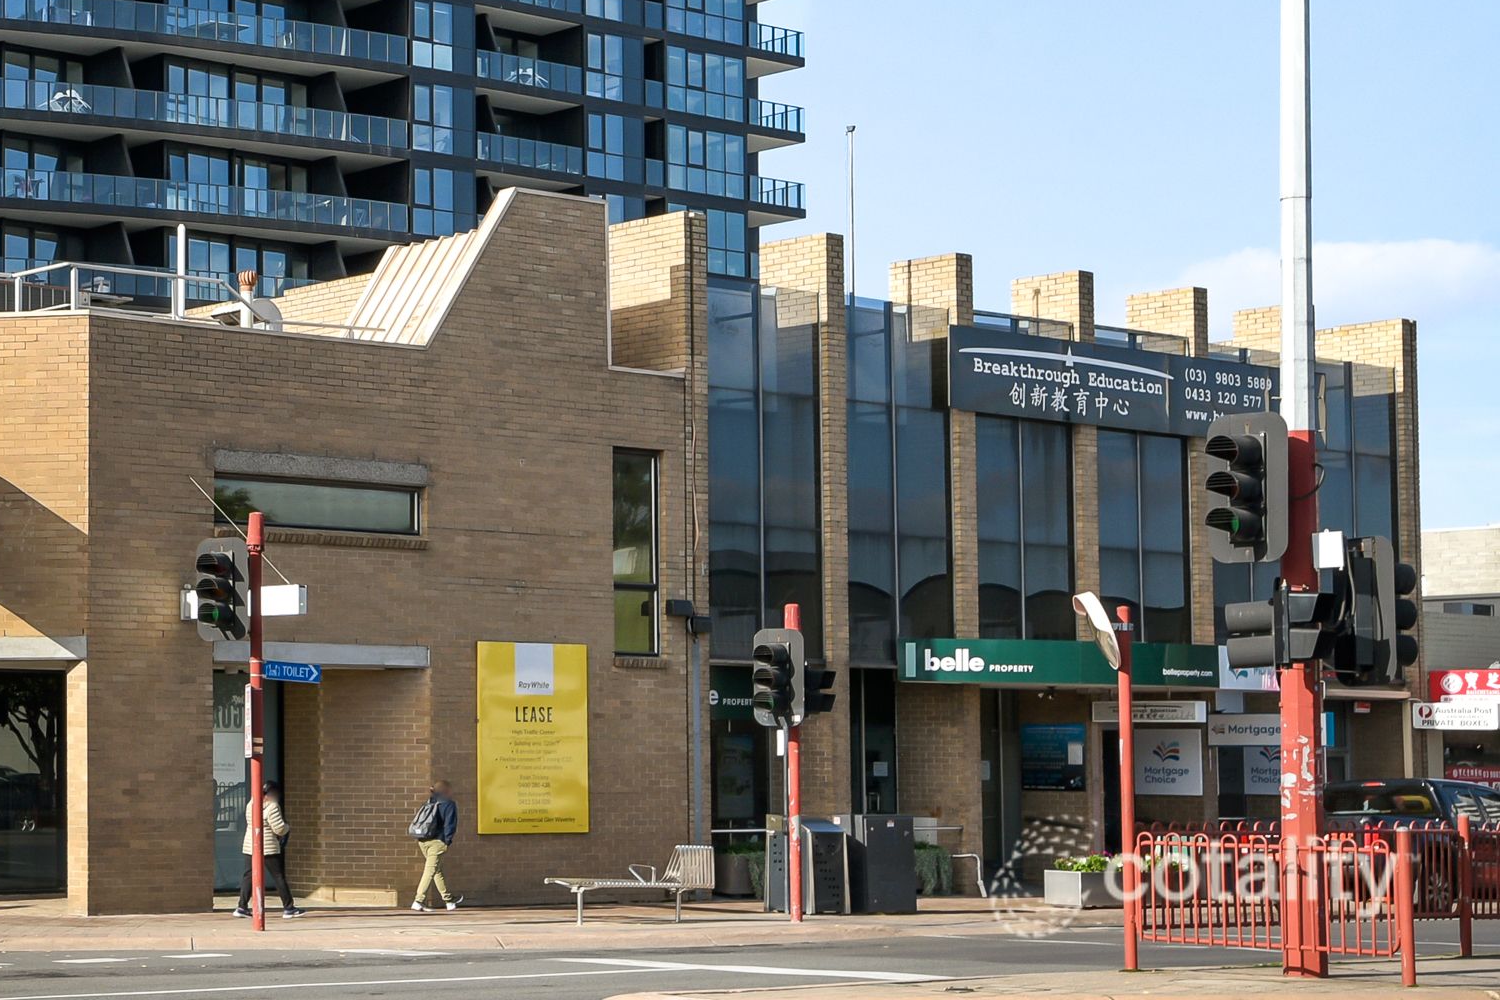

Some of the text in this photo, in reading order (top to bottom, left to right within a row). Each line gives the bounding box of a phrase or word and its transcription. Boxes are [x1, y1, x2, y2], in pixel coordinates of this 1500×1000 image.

[973, 357, 1163, 395] Breakthrough Education
[1184, 367, 1272, 391] (03) 9803 5889
[1008, 382, 1130, 419] 创新教育中心
[1184, 387, 1262, 408] 0433 120 577
[924, 648, 1034, 673] belle PROPERTY
[282, 665, 311, 678] TOILET
[1162, 667, 1213, 678] belleproperty.com
[518, 681, 550, 689] RayWhite
[722, 698, 752, 706] PROPERT
[515, 706, 553, 723] LEASE
[1434, 707, 1492, 715] Australia Post
[1421, 719, 1454, 727] PRIVATE
[1228, 724, 1280, 736] Mortgage
[1144, 766, 1189, 776] Mortgage
[1250, 766, 1280, 776] Mortg
[1144, 775, 1177, 784] Choice
